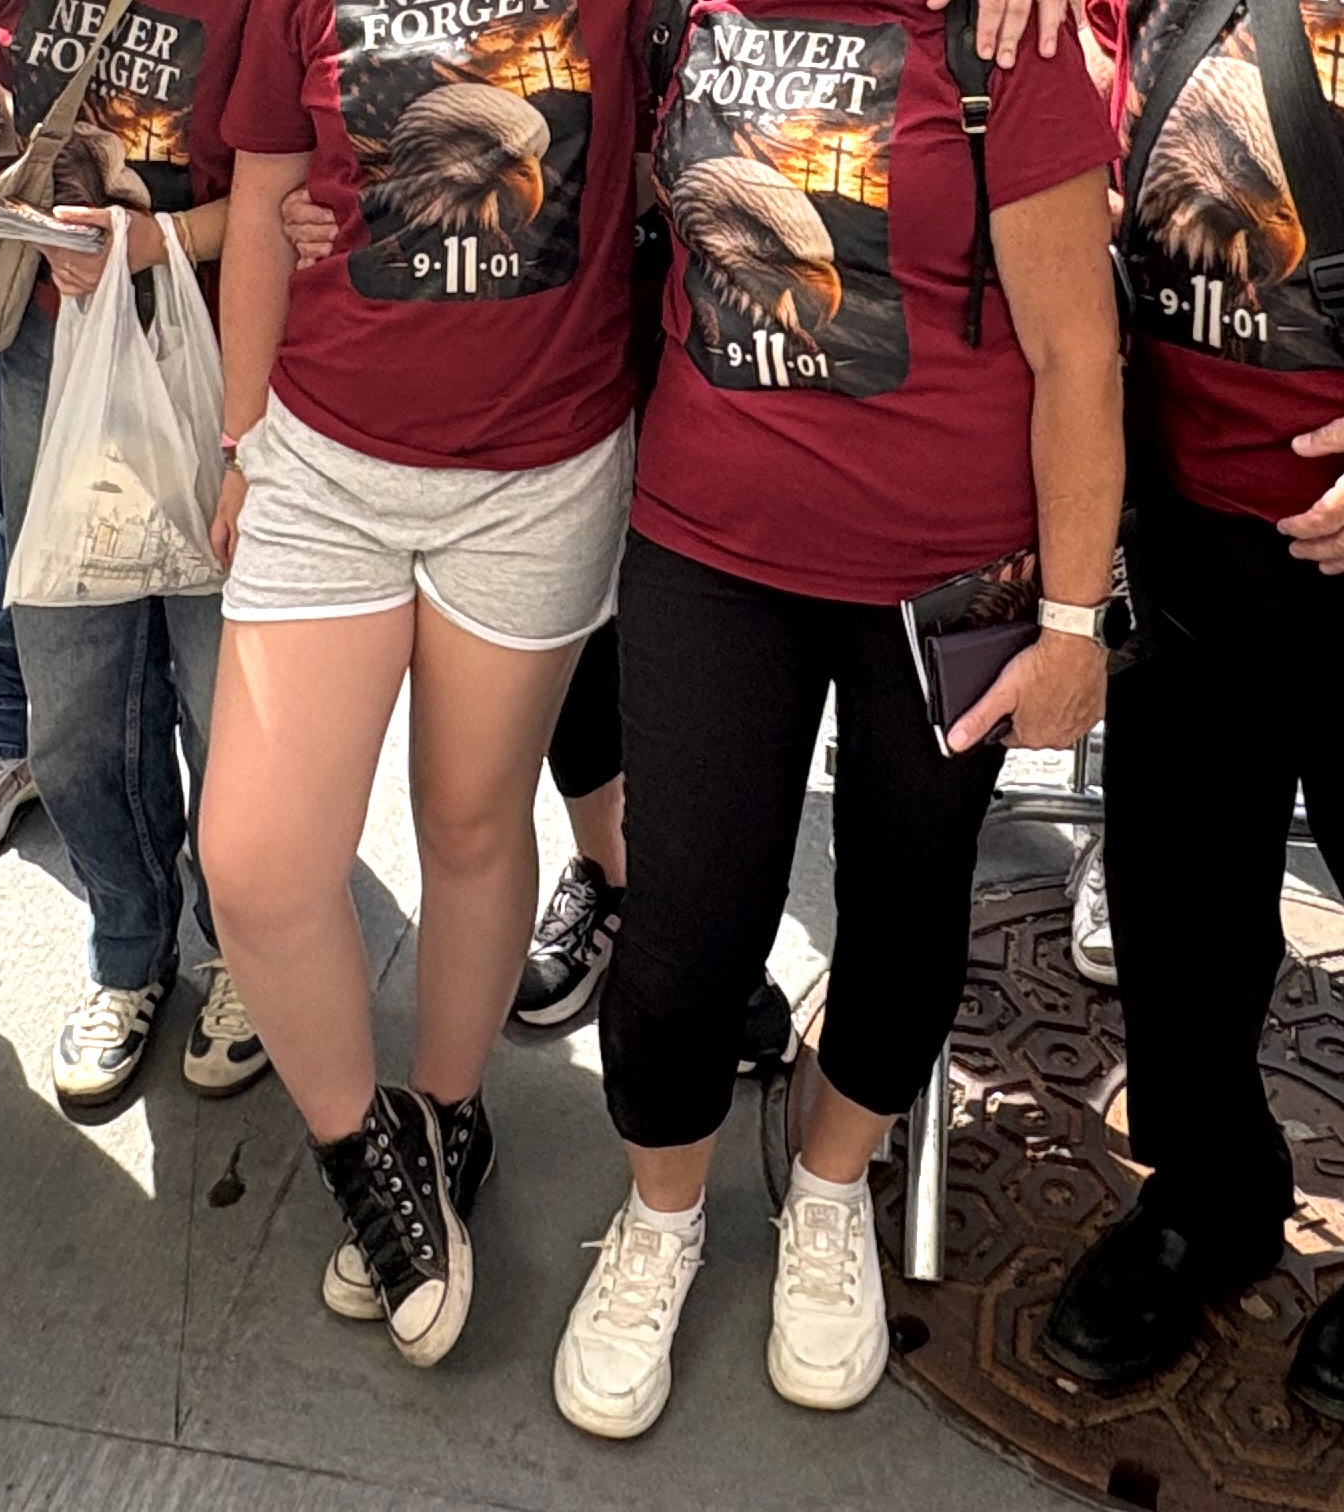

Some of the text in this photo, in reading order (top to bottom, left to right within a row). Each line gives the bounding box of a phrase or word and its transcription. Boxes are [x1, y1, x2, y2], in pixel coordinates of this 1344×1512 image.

[26, 31, 180, 101] FORGET
[712, 24, 866, 70] NEVER
[686, 65, 877, 116] FORGET
